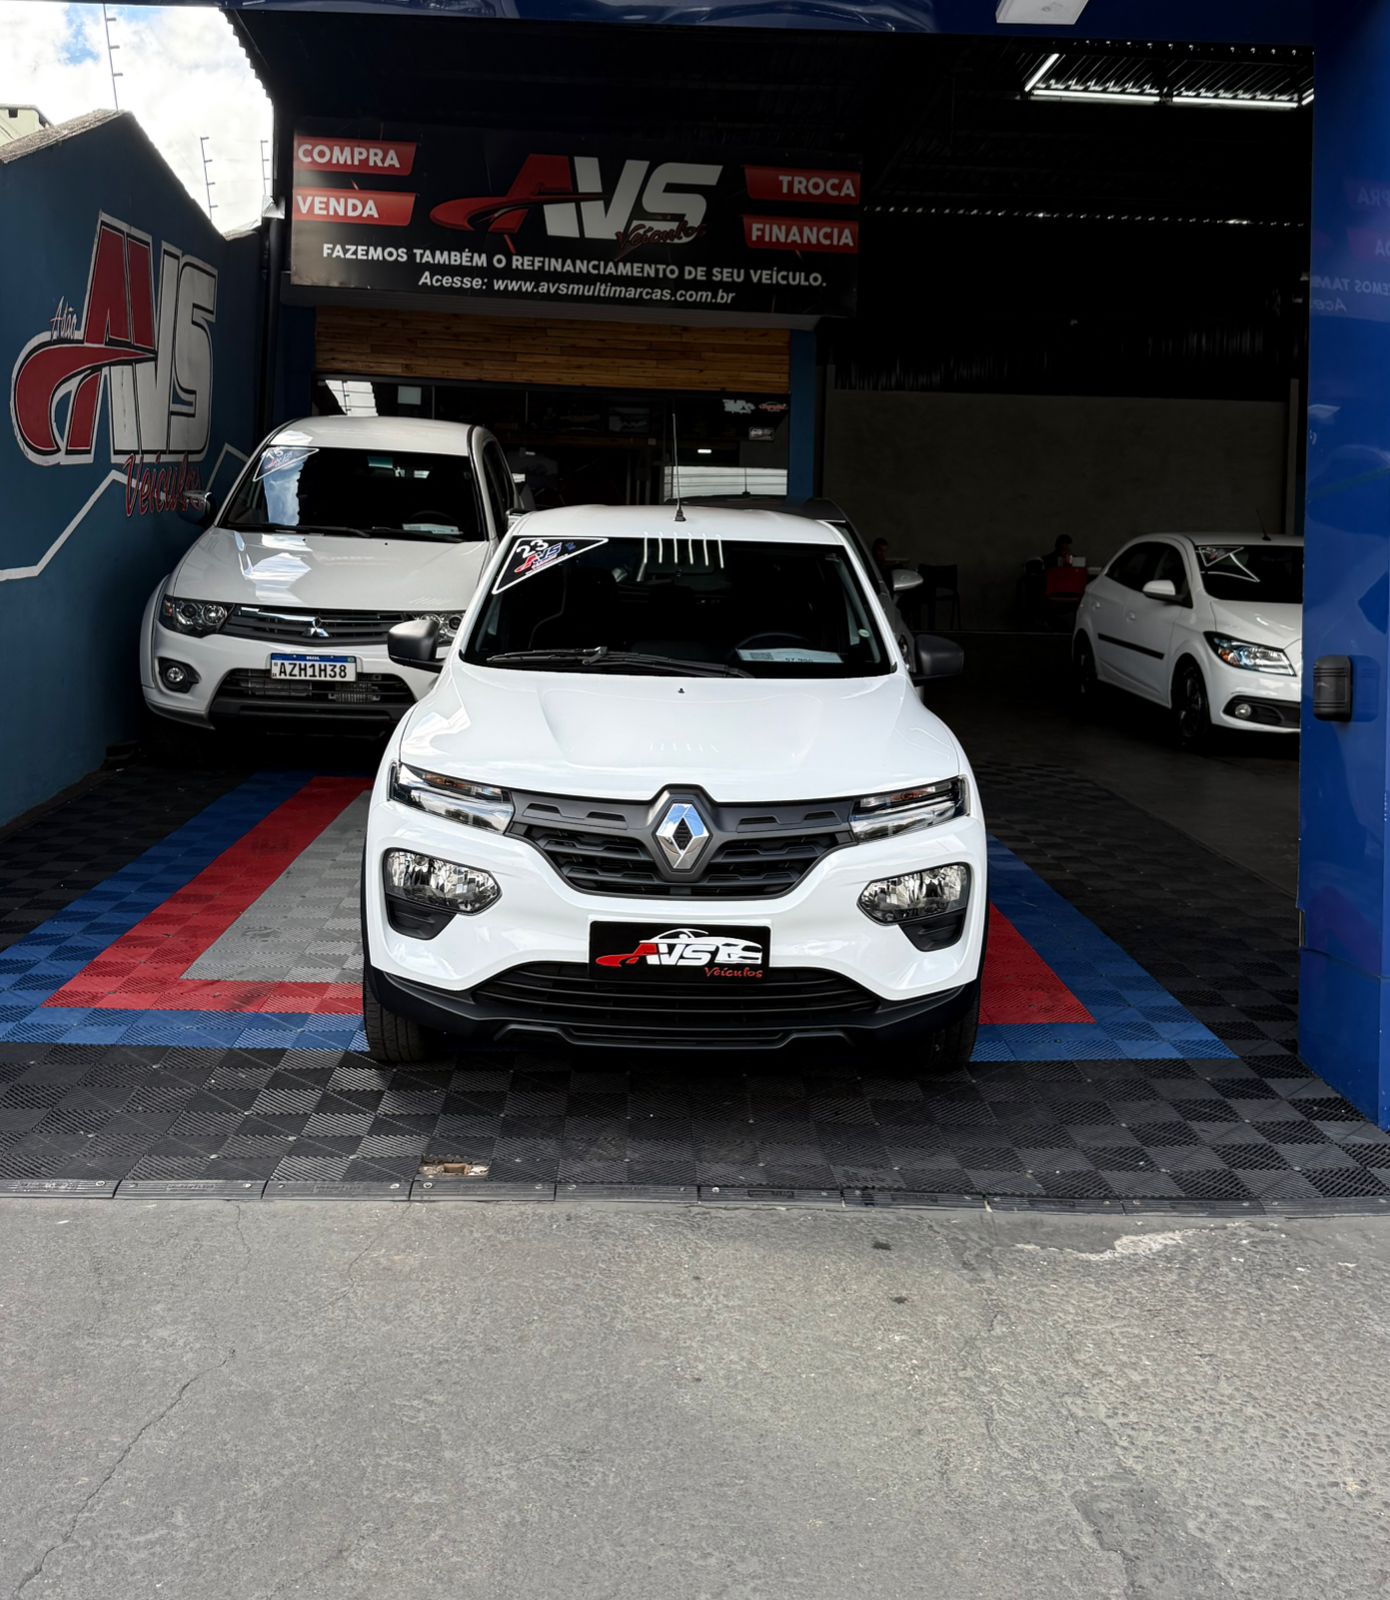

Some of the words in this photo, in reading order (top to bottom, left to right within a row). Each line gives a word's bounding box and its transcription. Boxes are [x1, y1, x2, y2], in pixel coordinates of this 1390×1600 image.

[298, 143, 401, 168] COMPRA
[430, 154, 723, 243] AVS
[778, 175, 856, 198] TROCA
[296, 195, 380, 218] VENDA
[751, 223, 855, 247] FINANCIA
[322, 243, 408, 262] FAZEMOS
[413, 248, 487, 268] TAMBÉM
[492, 254, 507, 269] O
[512, 254, 679, 280] REFINANCIAMENTO
[684, 266, 708, 281] DE
[712, 267, 745, 283] SEU
[749, 267, 827, 288] VEÍCULO.
[418, 271, 488, 290] Acesse:
[492, 277, 736, 304] www.avsmultimarcas.com.br
[10, 210, 218, 467] AVS
[516, 538, 549, 558] 23
[278, 662, 347, 679] AZH1H38
[595, 942, 717, 967] AVS
[704, 966, 763, 978] Veículos
